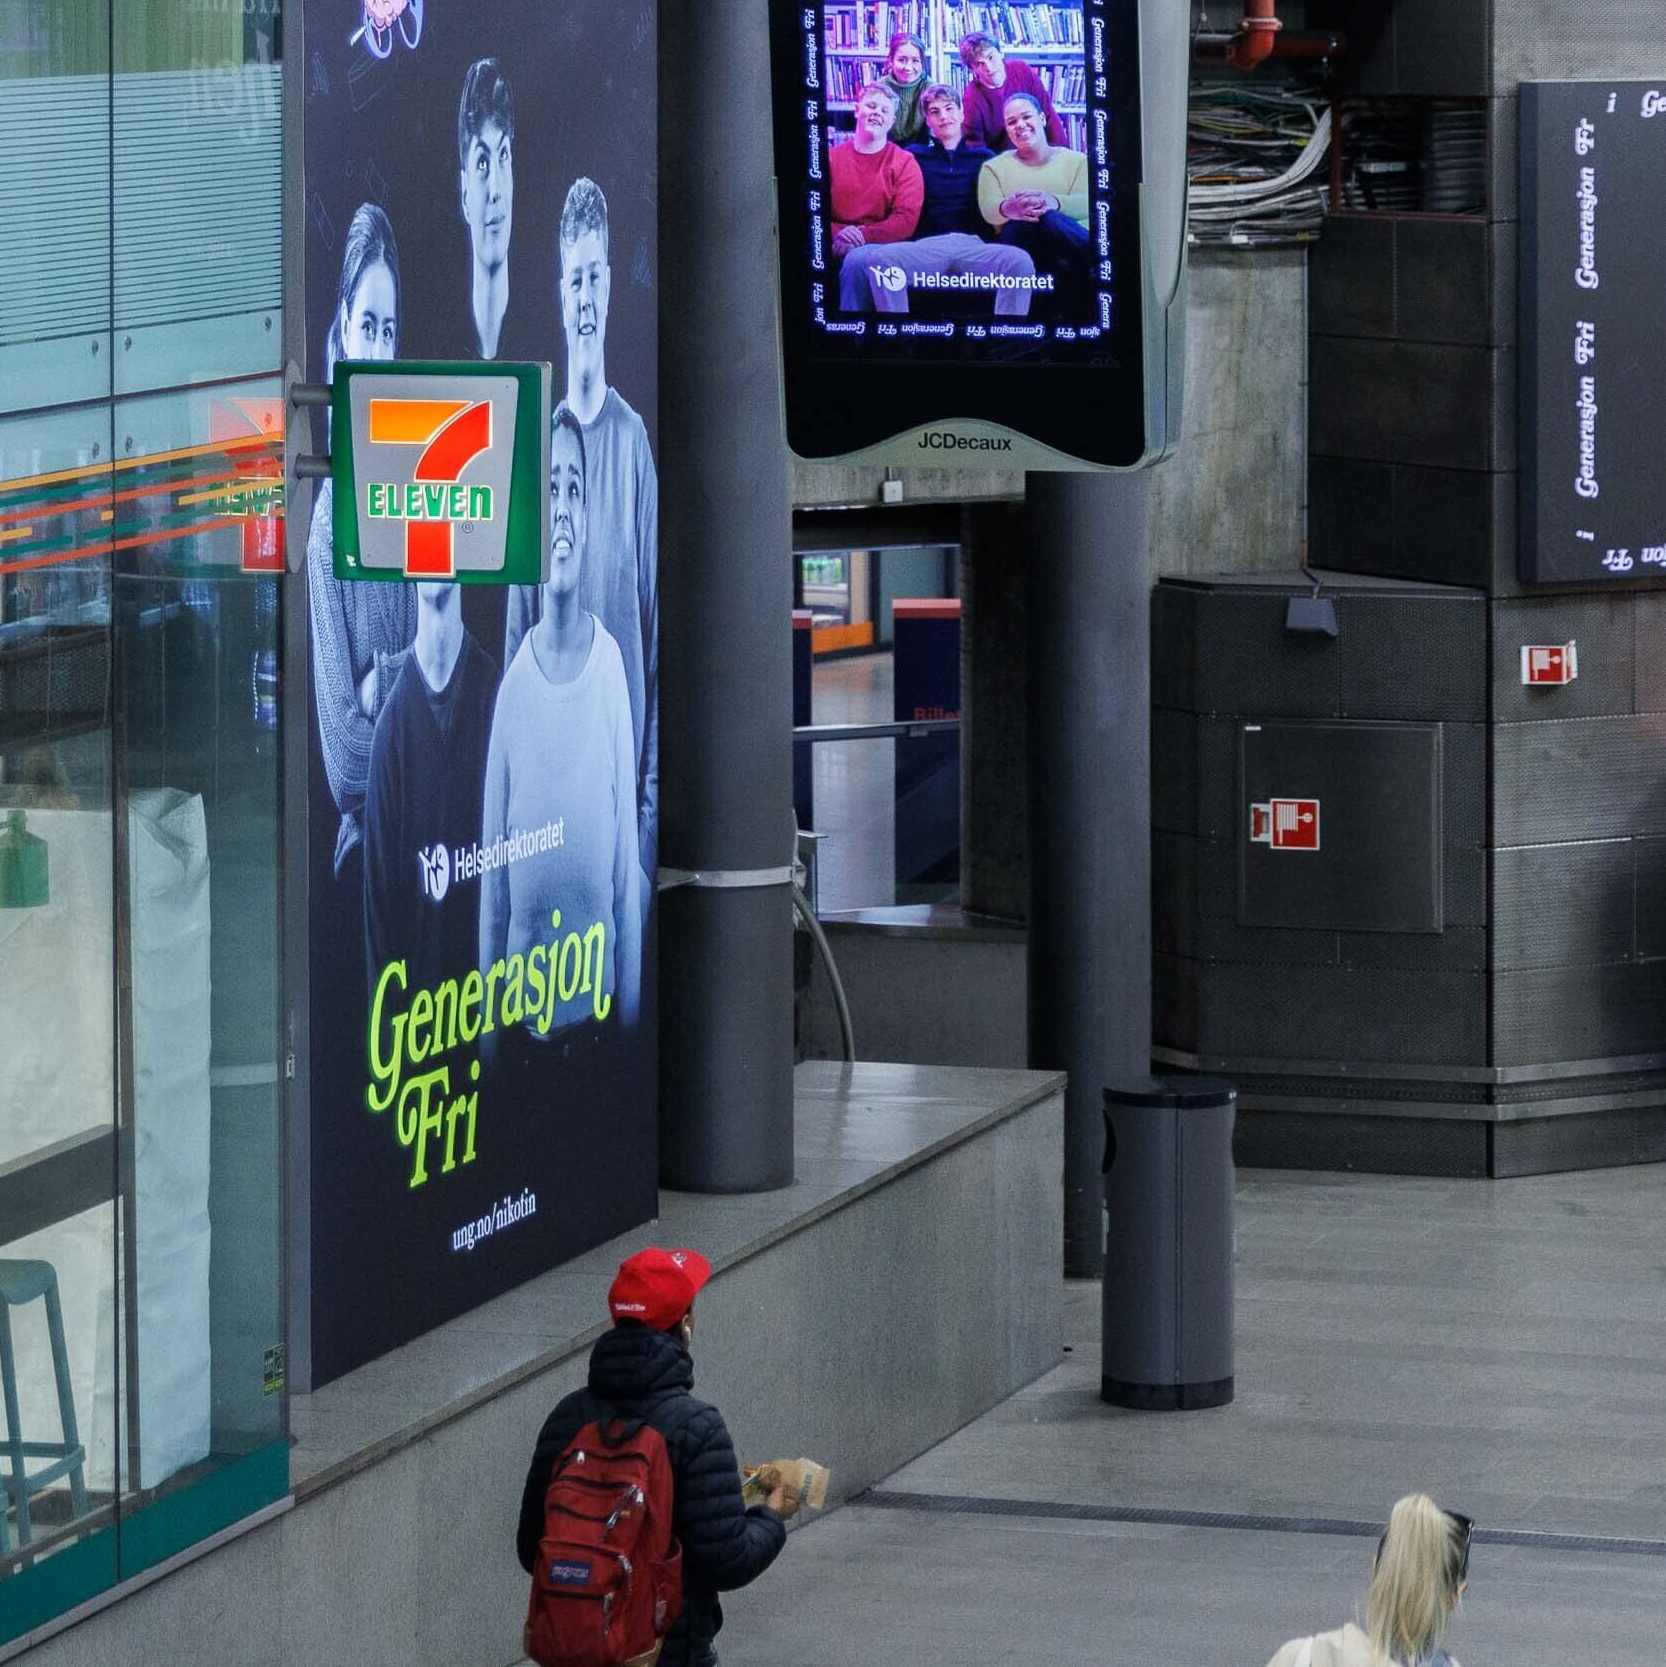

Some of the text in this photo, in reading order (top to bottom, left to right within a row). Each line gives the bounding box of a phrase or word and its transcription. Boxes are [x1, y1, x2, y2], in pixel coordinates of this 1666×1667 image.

[804, 8, 820, 88] Generasjon Fri
[1091, 17, 1107, 98] Generasjon Fri
[807, 99, 822, 179] Generasjon Fri
[1093, 109, 1109, 189] Generasjon Fri
[810, 190, 825, 269] Generasjon Fri
[1096, 201, 1112, 281] Generasjon Fri
[1574, 166, 1599, 289] Generasjon
[813, 282, 824, 303] Fri
[913, 271, 1054, 291] Helsedirektoratet
[918, 432, 1013, 453] JCDecaux
[1574, 321, 1599, 498] Generasjon Fri
[367, 484, 494, 520] ELEVEN
[370, 399, 492, 575] 7
[455, 817, 564, 882] Helsedirektoratet
[368, 909, 611, 1112] Generasjon
[398, 1060, 481, 1188] Fri
[452, 1188, 537, 1250] ung.no/nikotin
